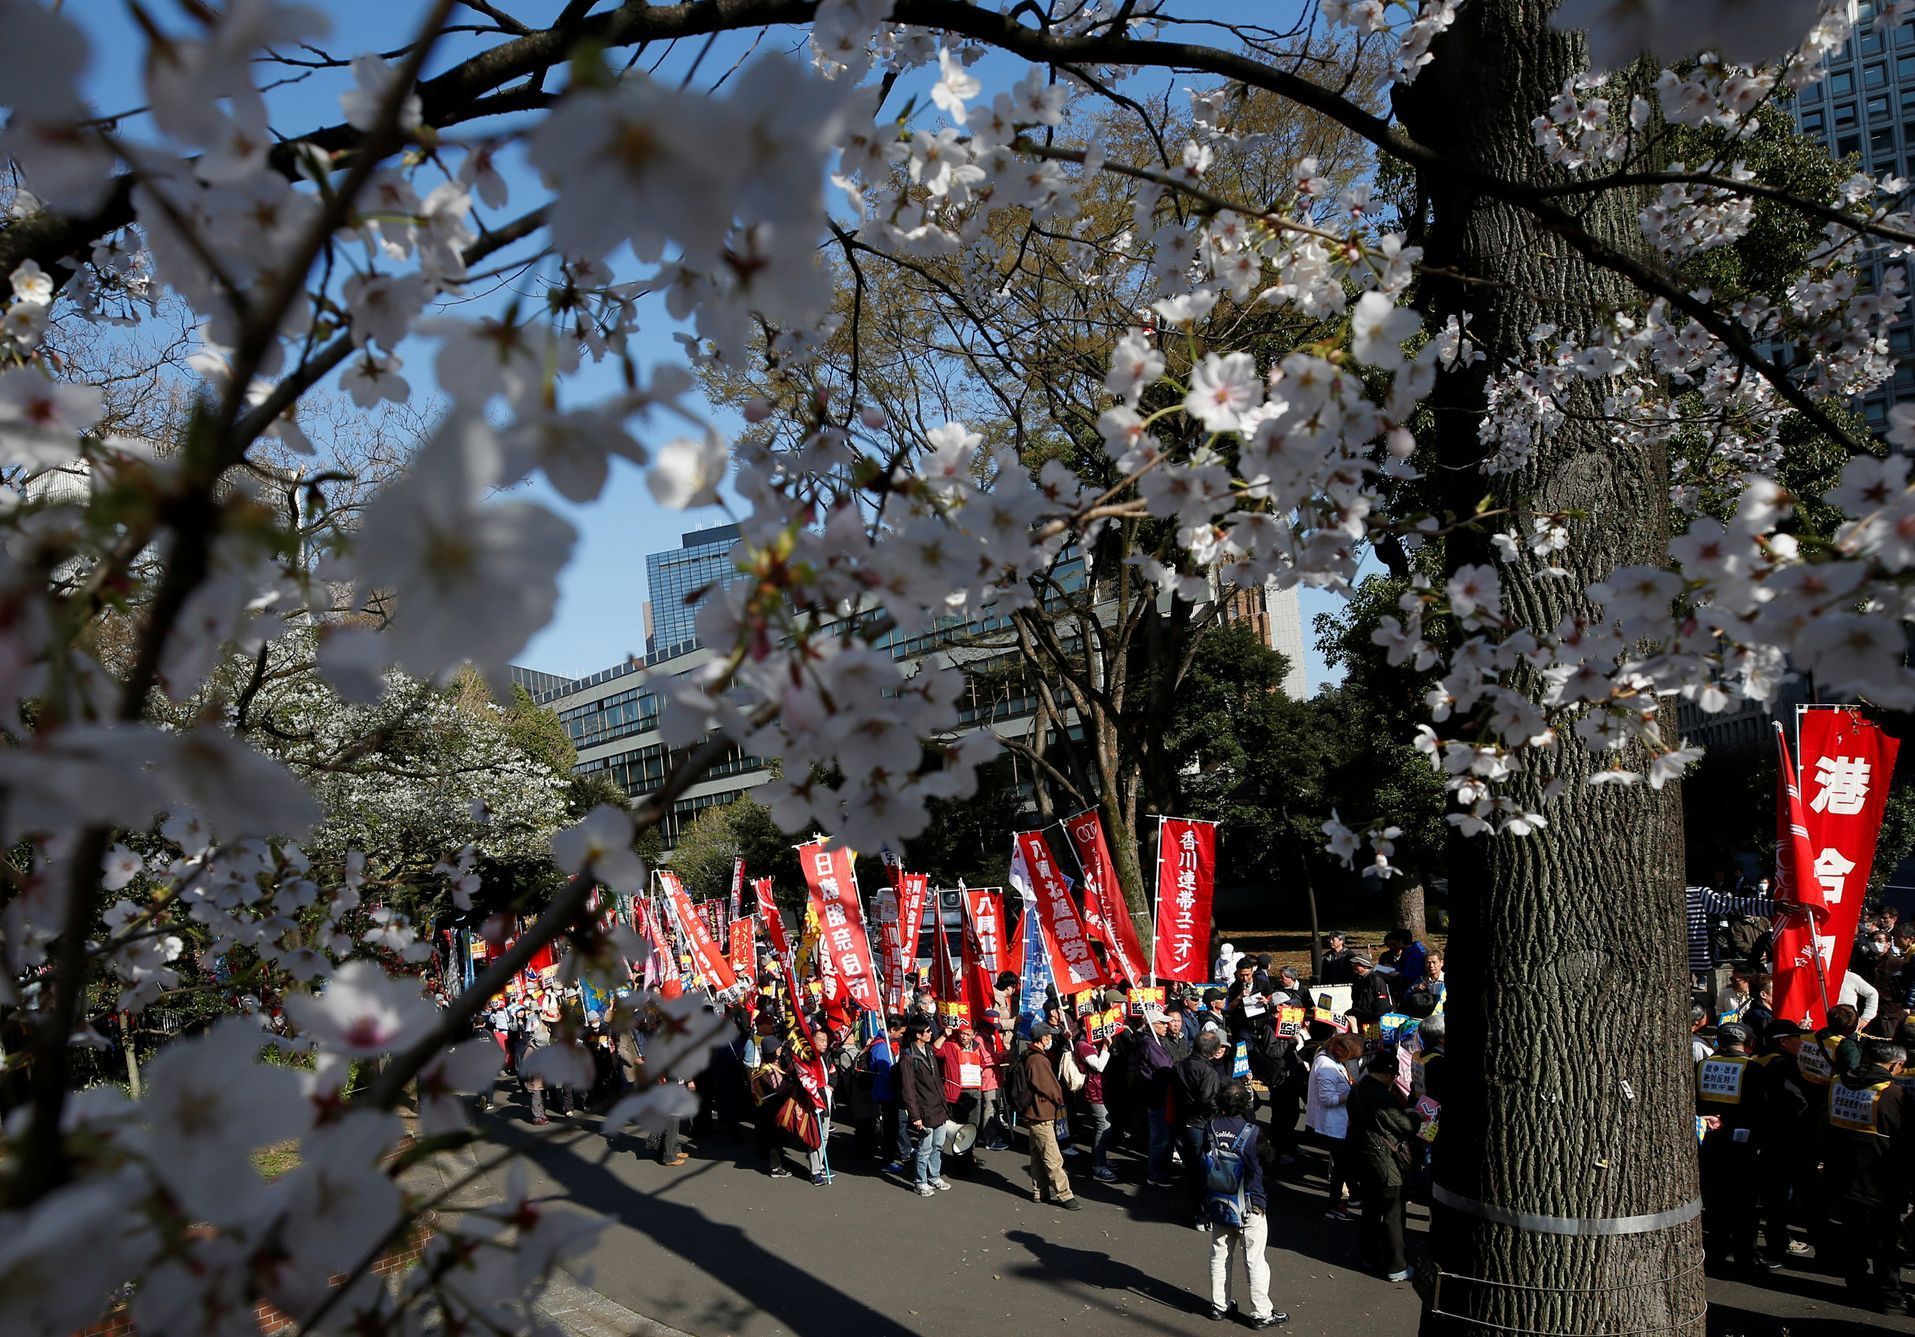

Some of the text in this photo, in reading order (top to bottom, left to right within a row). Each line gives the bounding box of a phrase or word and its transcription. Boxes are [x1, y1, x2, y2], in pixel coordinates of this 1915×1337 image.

[1173, 829, 1200, 974] 香川連帯ユニオン
